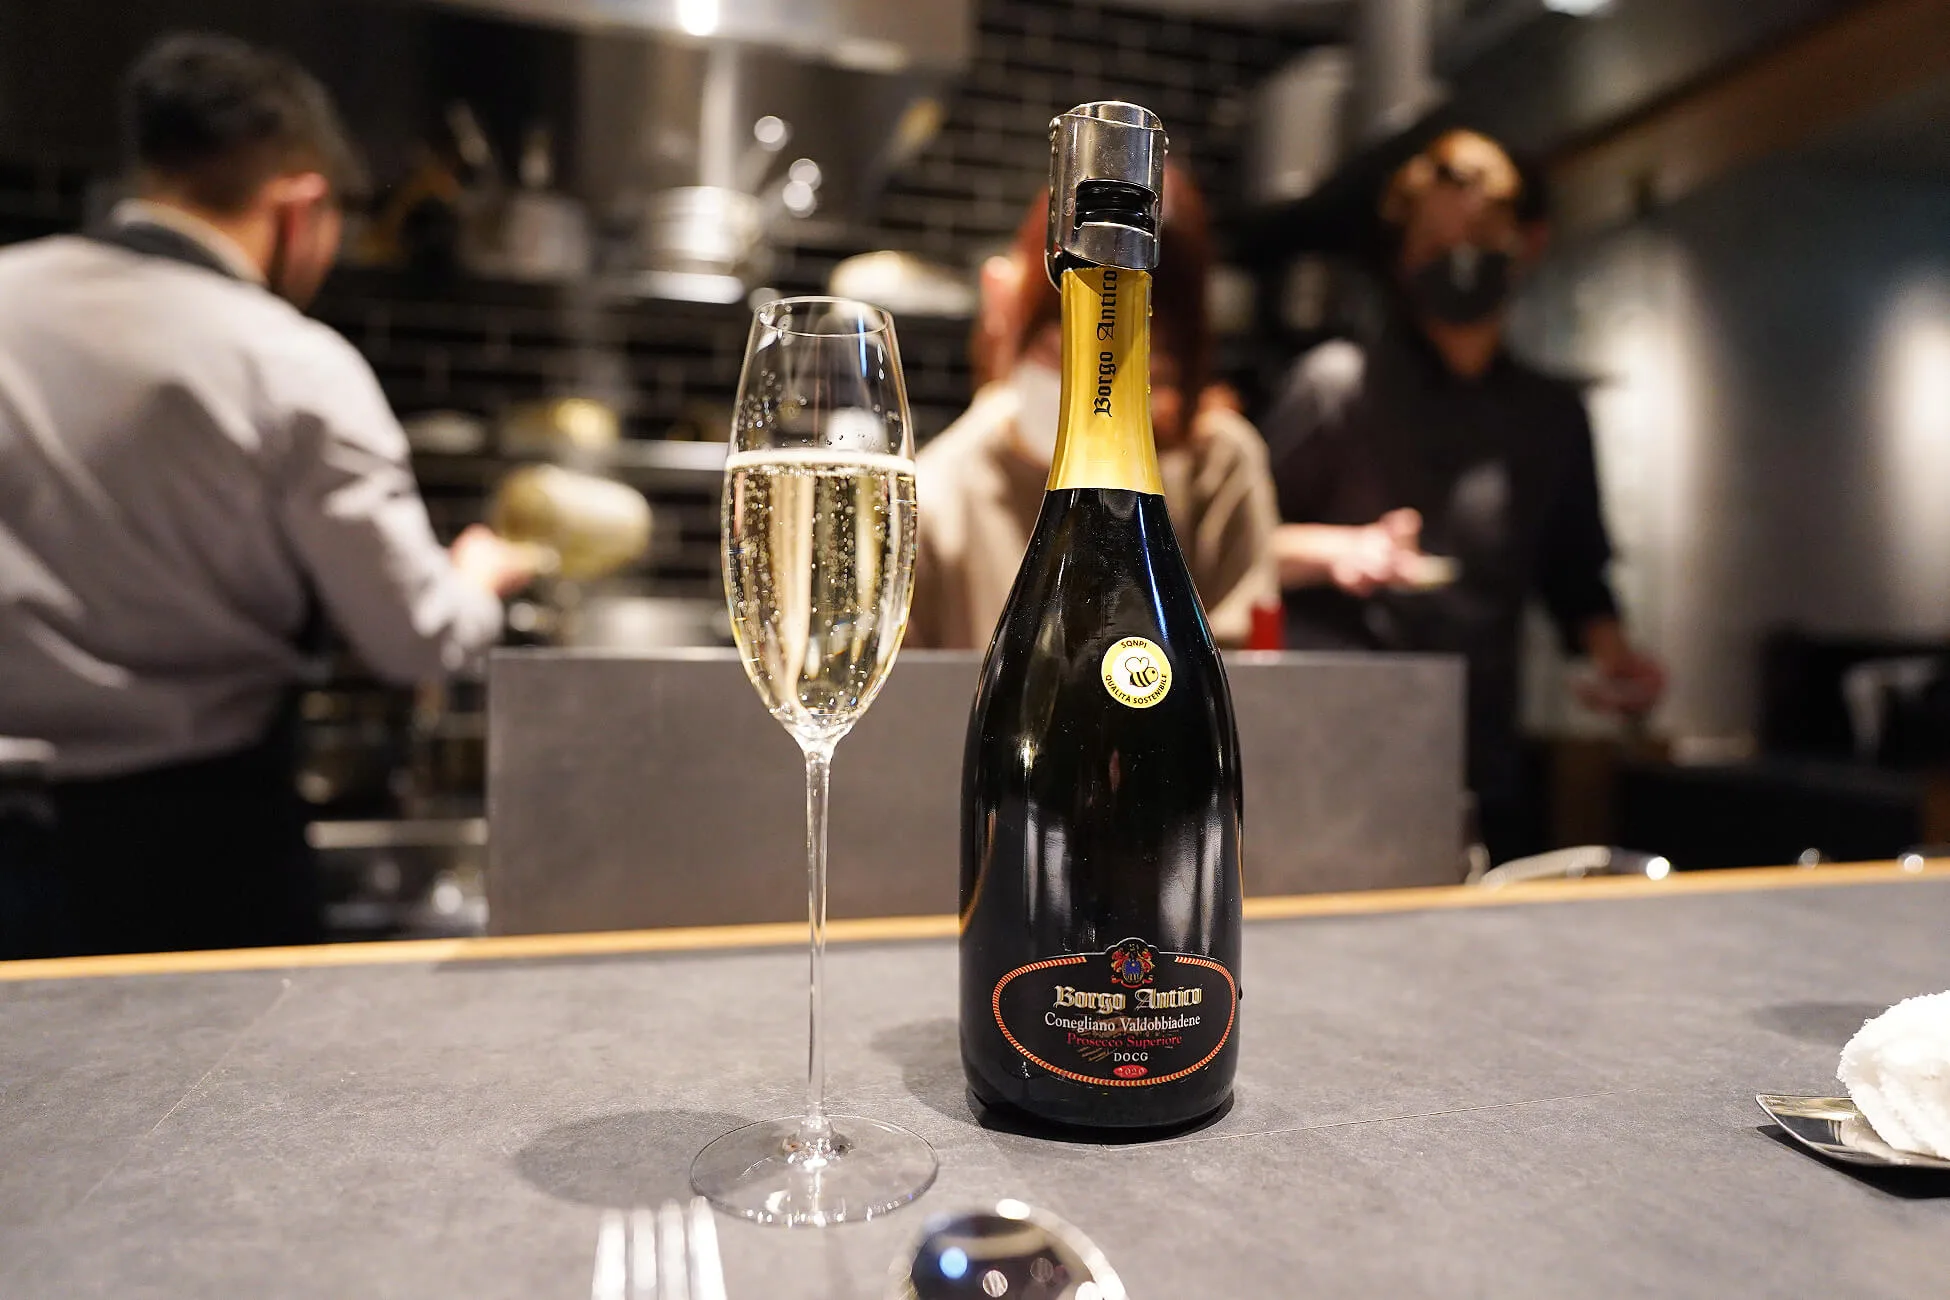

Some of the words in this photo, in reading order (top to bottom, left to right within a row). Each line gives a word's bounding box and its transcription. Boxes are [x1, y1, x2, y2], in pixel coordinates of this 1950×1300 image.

[1097, 270, 1117, 341] Antico
[1094, 351, 1117, 417] Borgo
[1121, 640, 1147, 649] SQNPI
[1105, 674, 1131, 702] QUALITÀ
[1133, 673, 1168, 704] SOSTENIBILE
[1053, 985, 1126, 1014] Borgo
[1135, 985, 1202, 1010] Antico
[1045, 1011, 1115, 1032] Conegliano
[1120, 1013, 1201, 1032] Valdobbiadene
[1067, 1032, 1123, 1047] Prosecco
[1127, 1034, 1182, 1048] Superiore
[1113, 1052, 1149, 1062] DOCG
